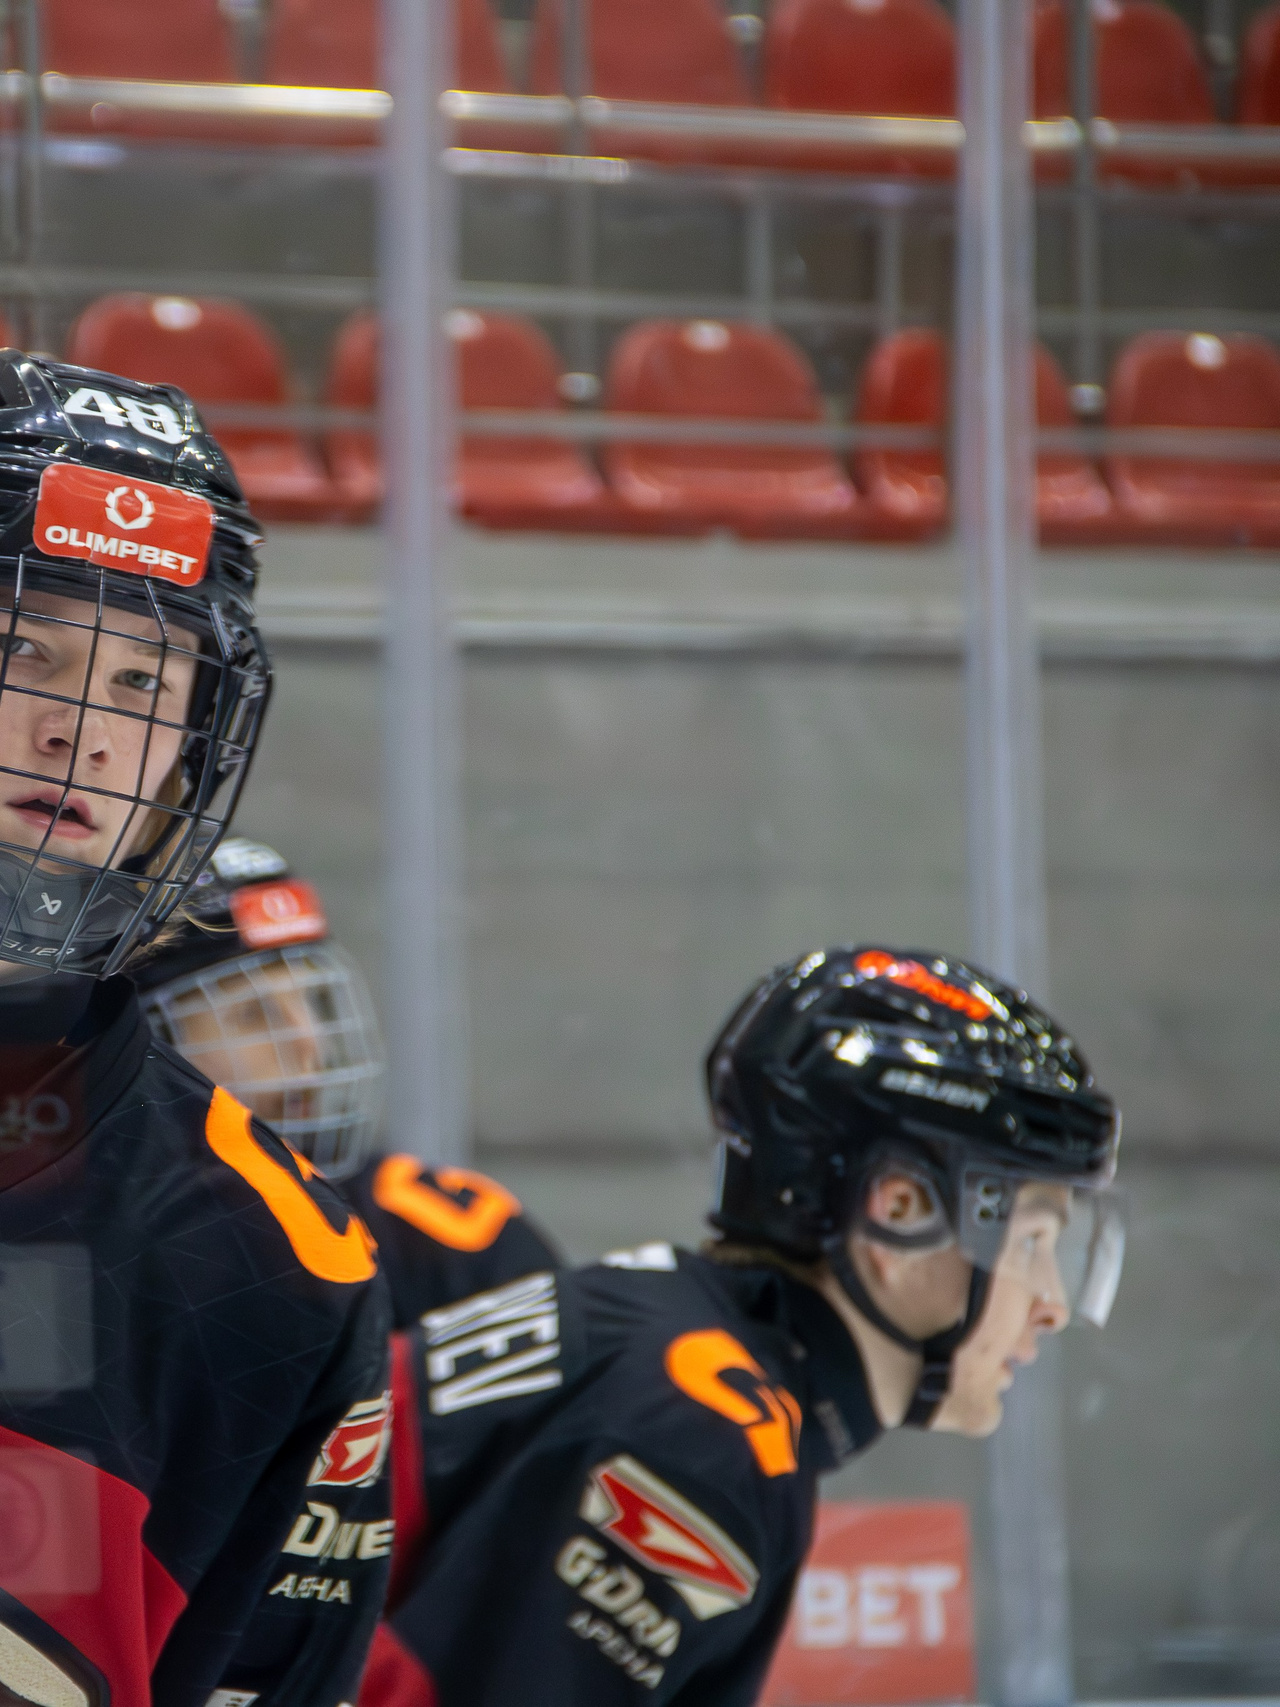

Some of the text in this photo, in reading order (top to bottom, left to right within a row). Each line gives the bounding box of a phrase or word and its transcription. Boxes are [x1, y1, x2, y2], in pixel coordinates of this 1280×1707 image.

[63, 387, 185, 444] 48
[44, 525, 198, 575] OLIMPBET
[794, 1564, 962, 1649] BET
